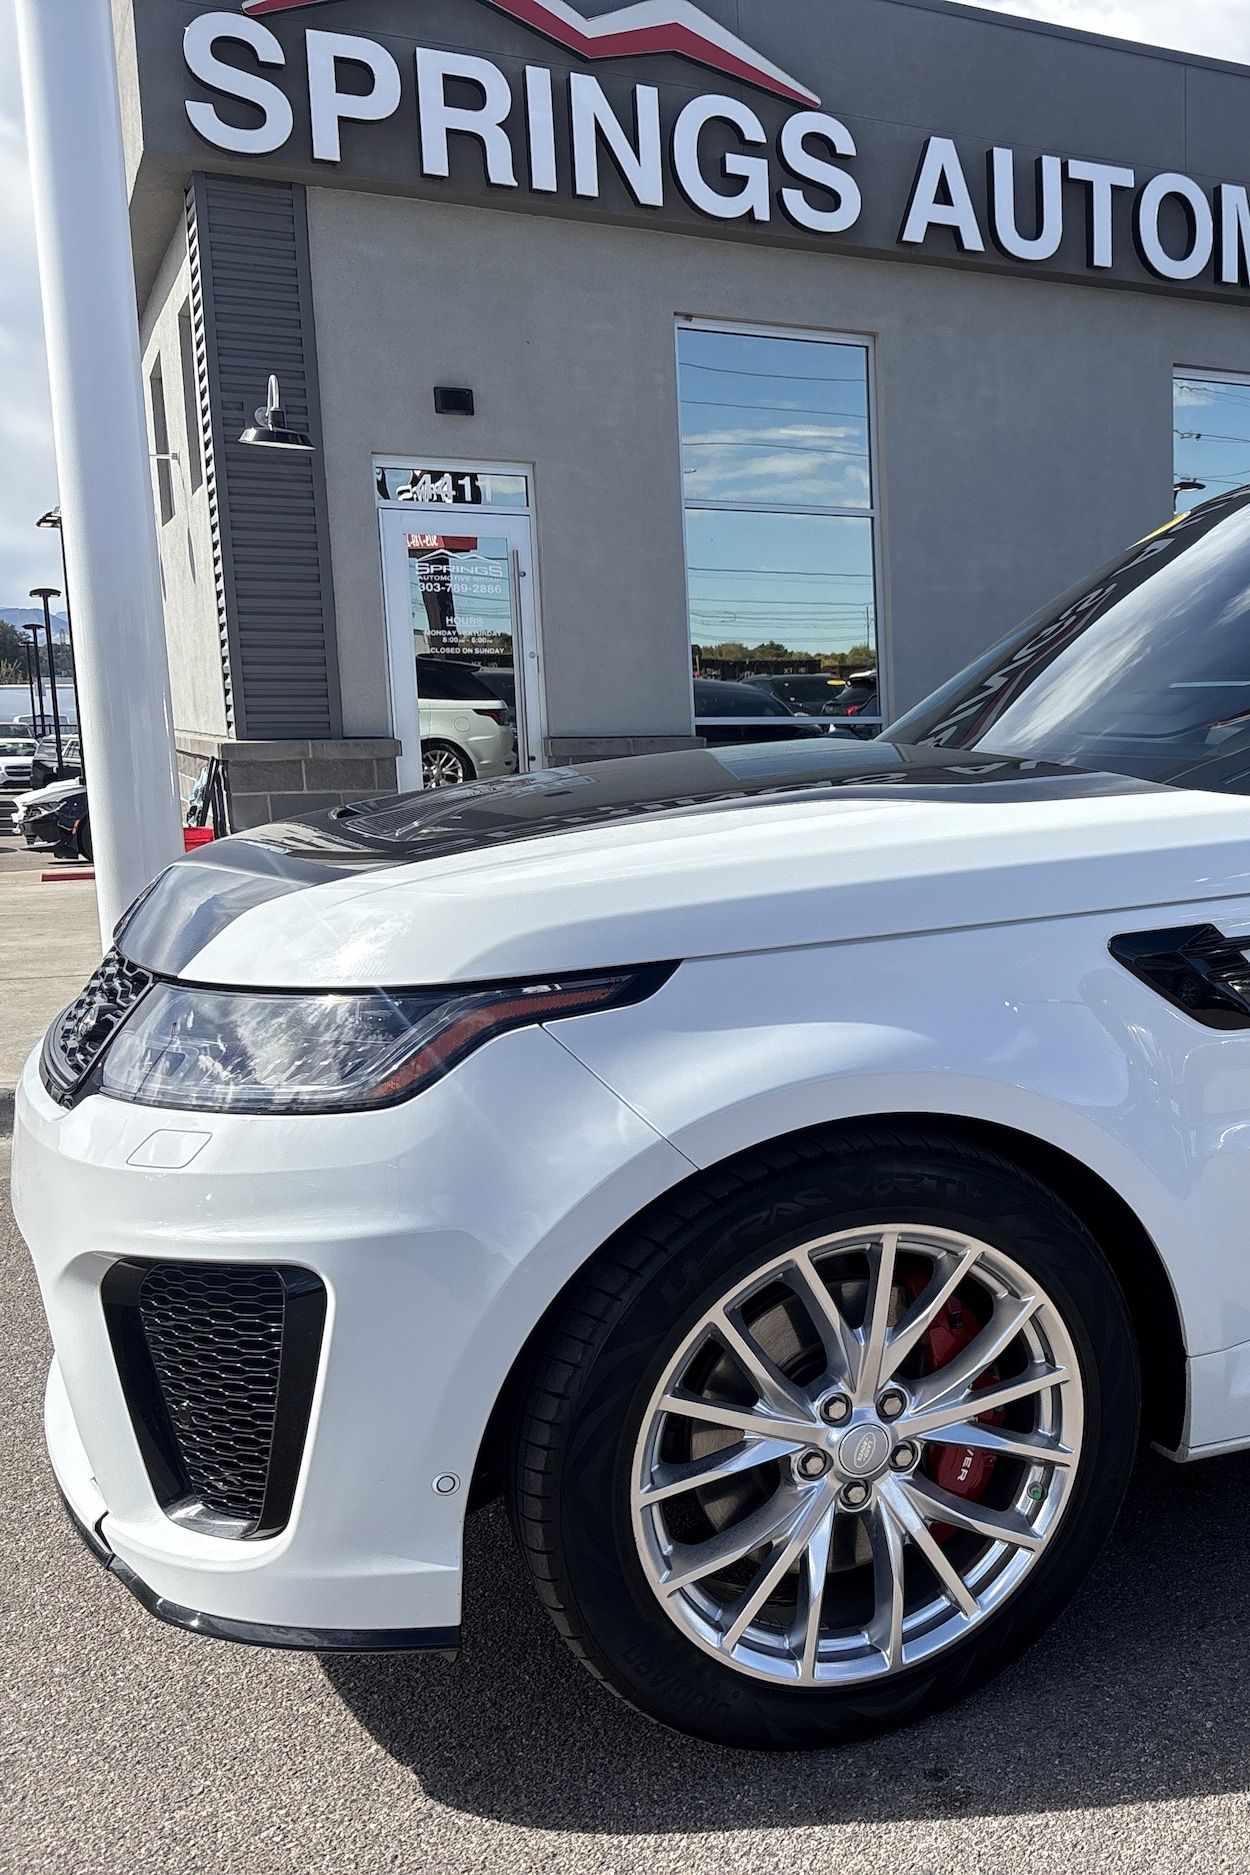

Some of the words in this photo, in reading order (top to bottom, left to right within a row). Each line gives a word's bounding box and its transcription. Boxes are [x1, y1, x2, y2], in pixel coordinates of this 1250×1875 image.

[184, 11, 863, 234] SPRINGS
[415, 562, 503, 577] SPRINGS
[419, 582, 502, 593] 303-789-2886
[446, 616, 483, 626] HOURS
